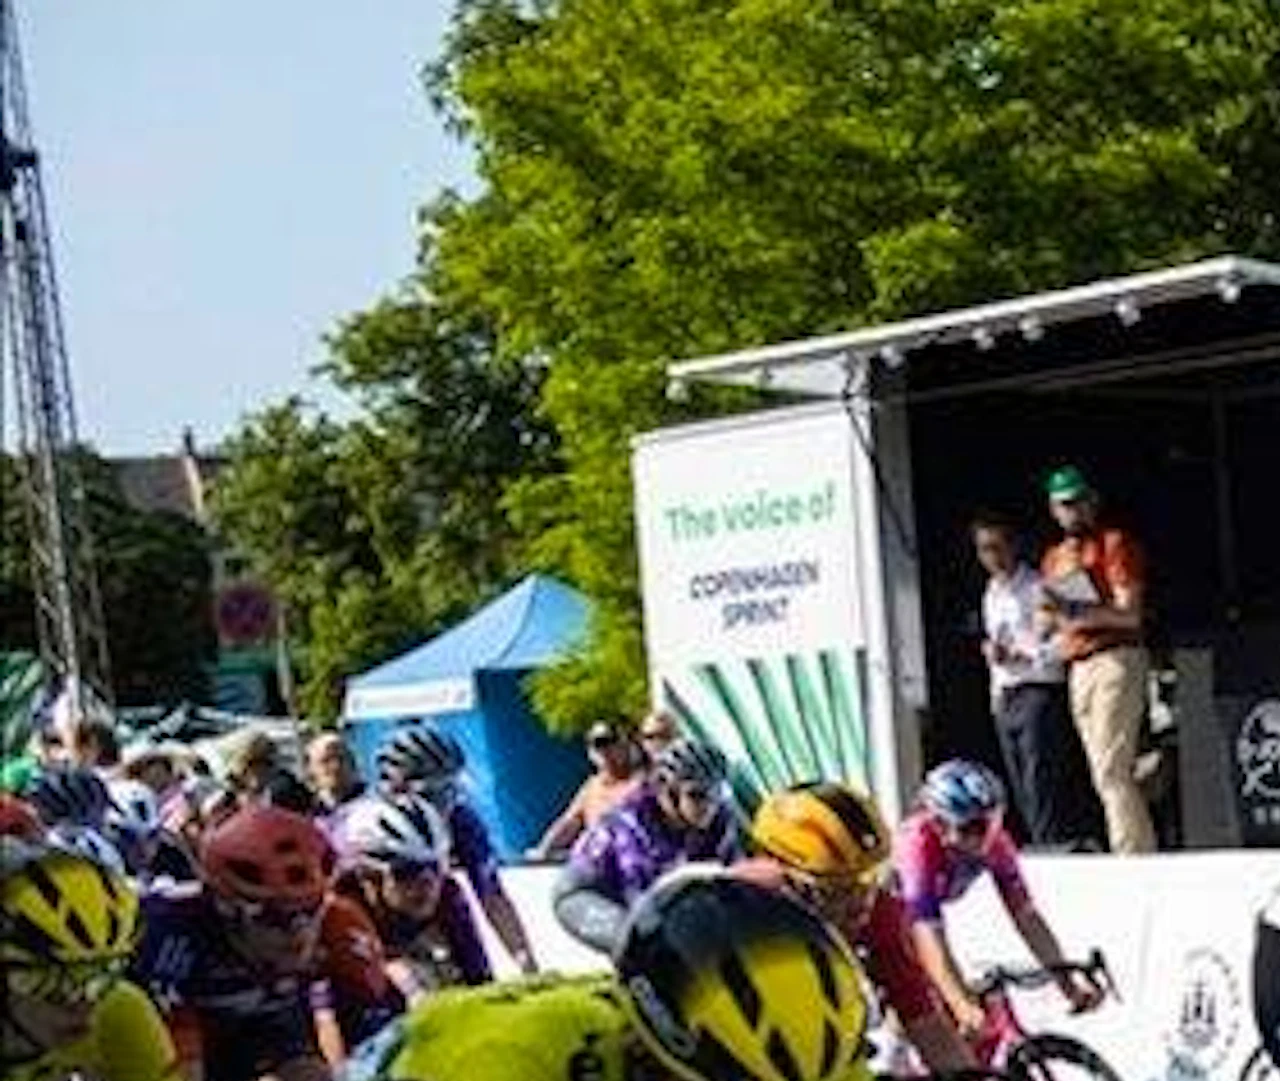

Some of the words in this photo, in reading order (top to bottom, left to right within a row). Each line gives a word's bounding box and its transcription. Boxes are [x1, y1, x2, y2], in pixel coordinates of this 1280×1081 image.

[664, 502, 717, 540] The
[721, 488, 803, 531] voice
[808, 480, 836, 522] of
